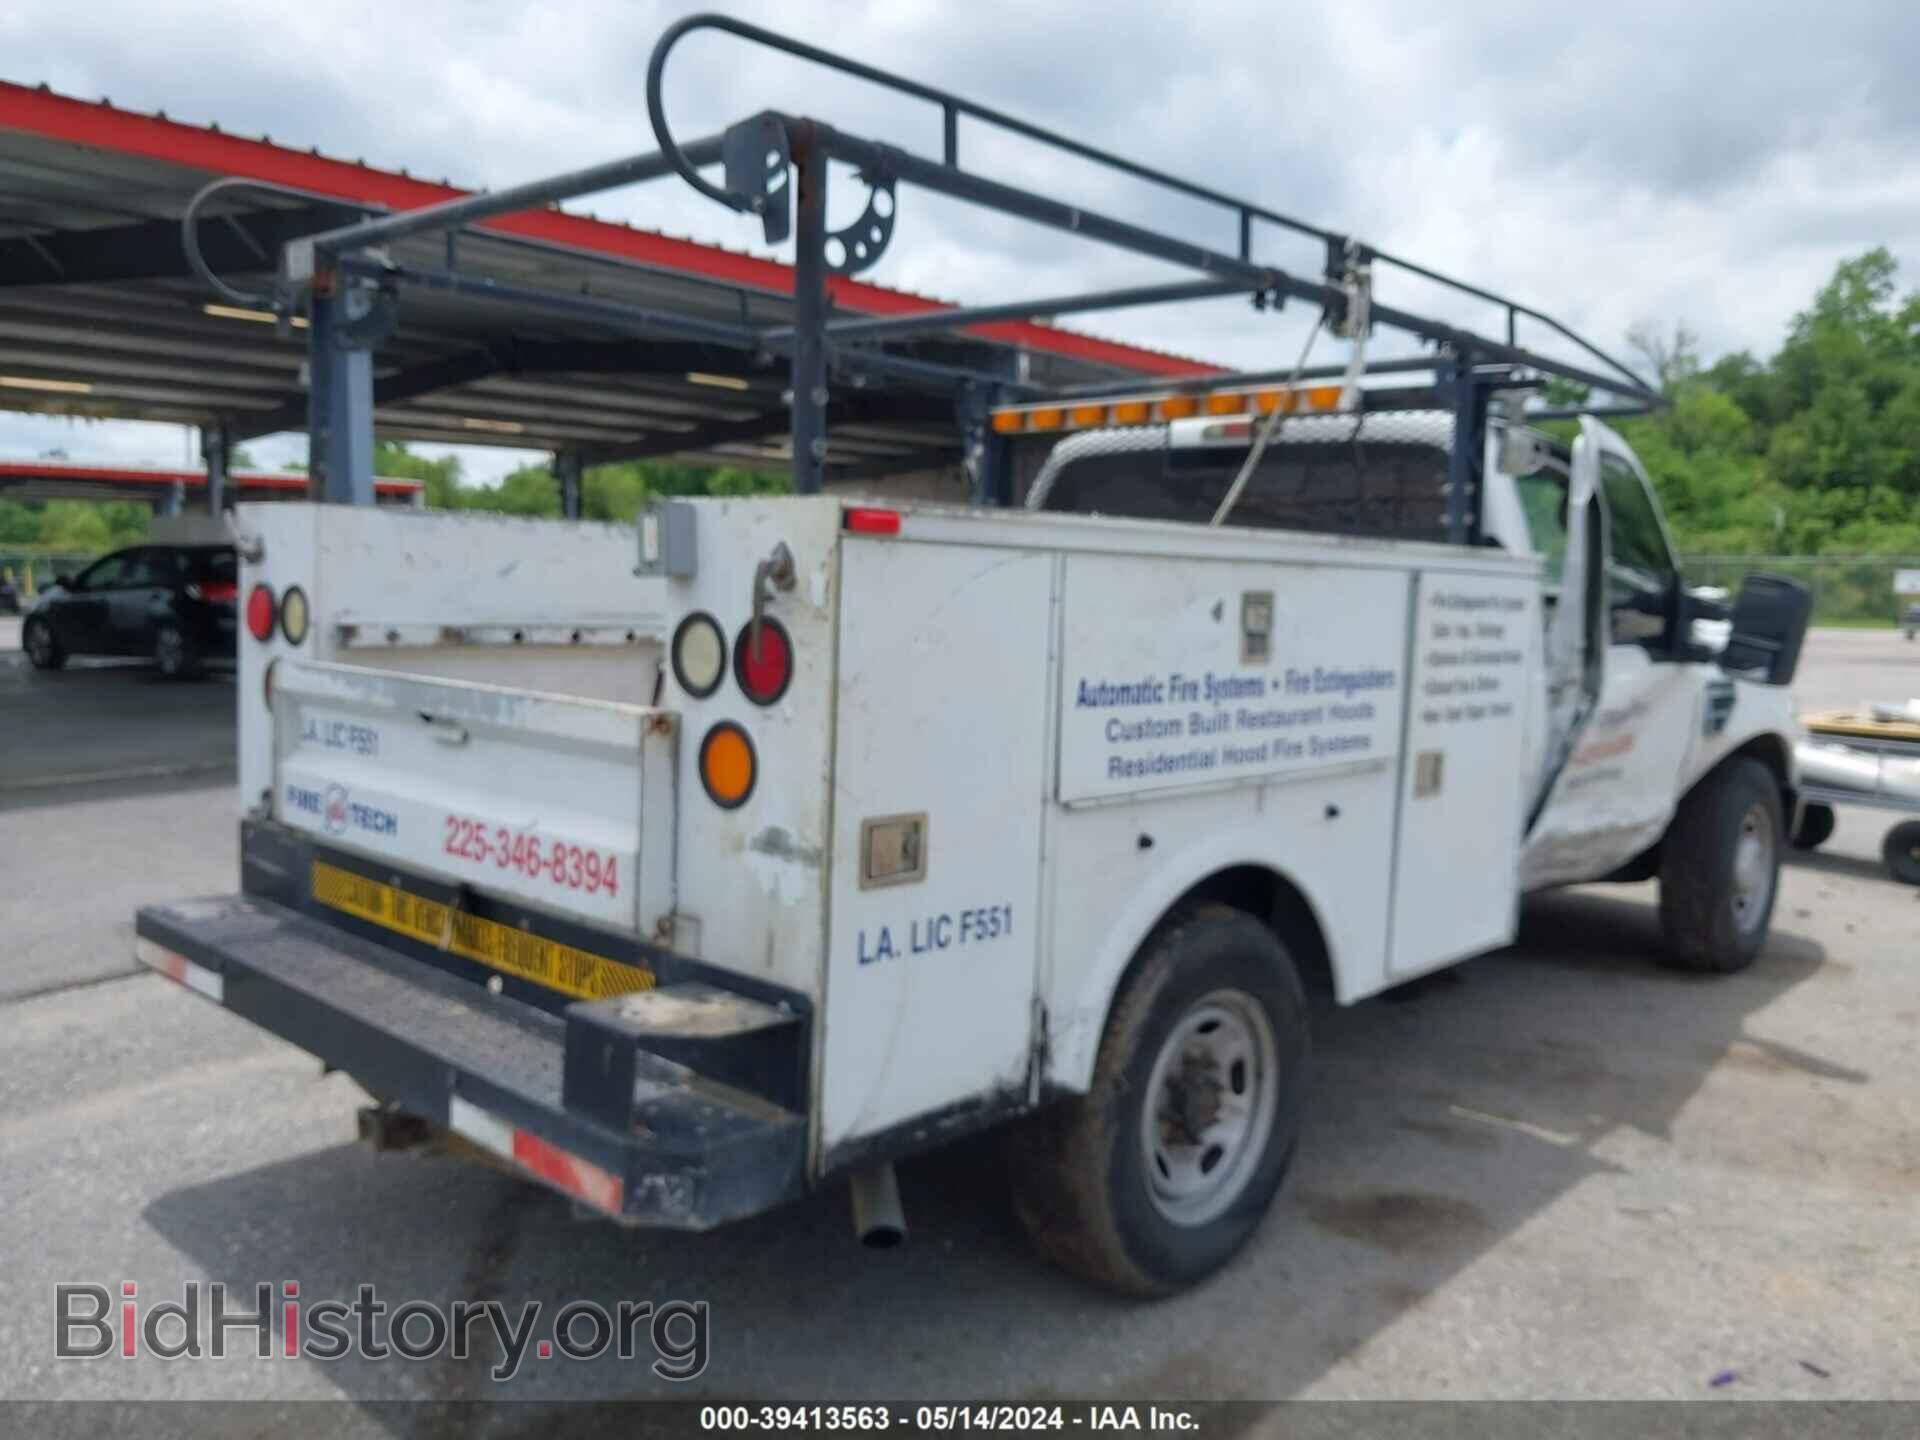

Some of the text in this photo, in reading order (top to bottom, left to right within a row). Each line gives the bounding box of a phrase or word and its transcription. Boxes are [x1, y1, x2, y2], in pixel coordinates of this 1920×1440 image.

[1075, 676, 1162, 708] Automatic
[1168, 675, 1198, 702] Fire
[1205, 672, 1265, 706] Systems
[1285, 669, 1310, 695] Fire
[1106, 717, 1183, 743] Custom
[1189, 711, 1231, 736] Built
[1237, 705, 1323, 729] Restaurant
[1107, 732, 1371, 779] Residential Hood Fire Systems
[351, 803, 398, 837] TECH
[443, 814, 619, 896] 225-346-8394
[858, 904, 1013, 965] LA. LIC F551
